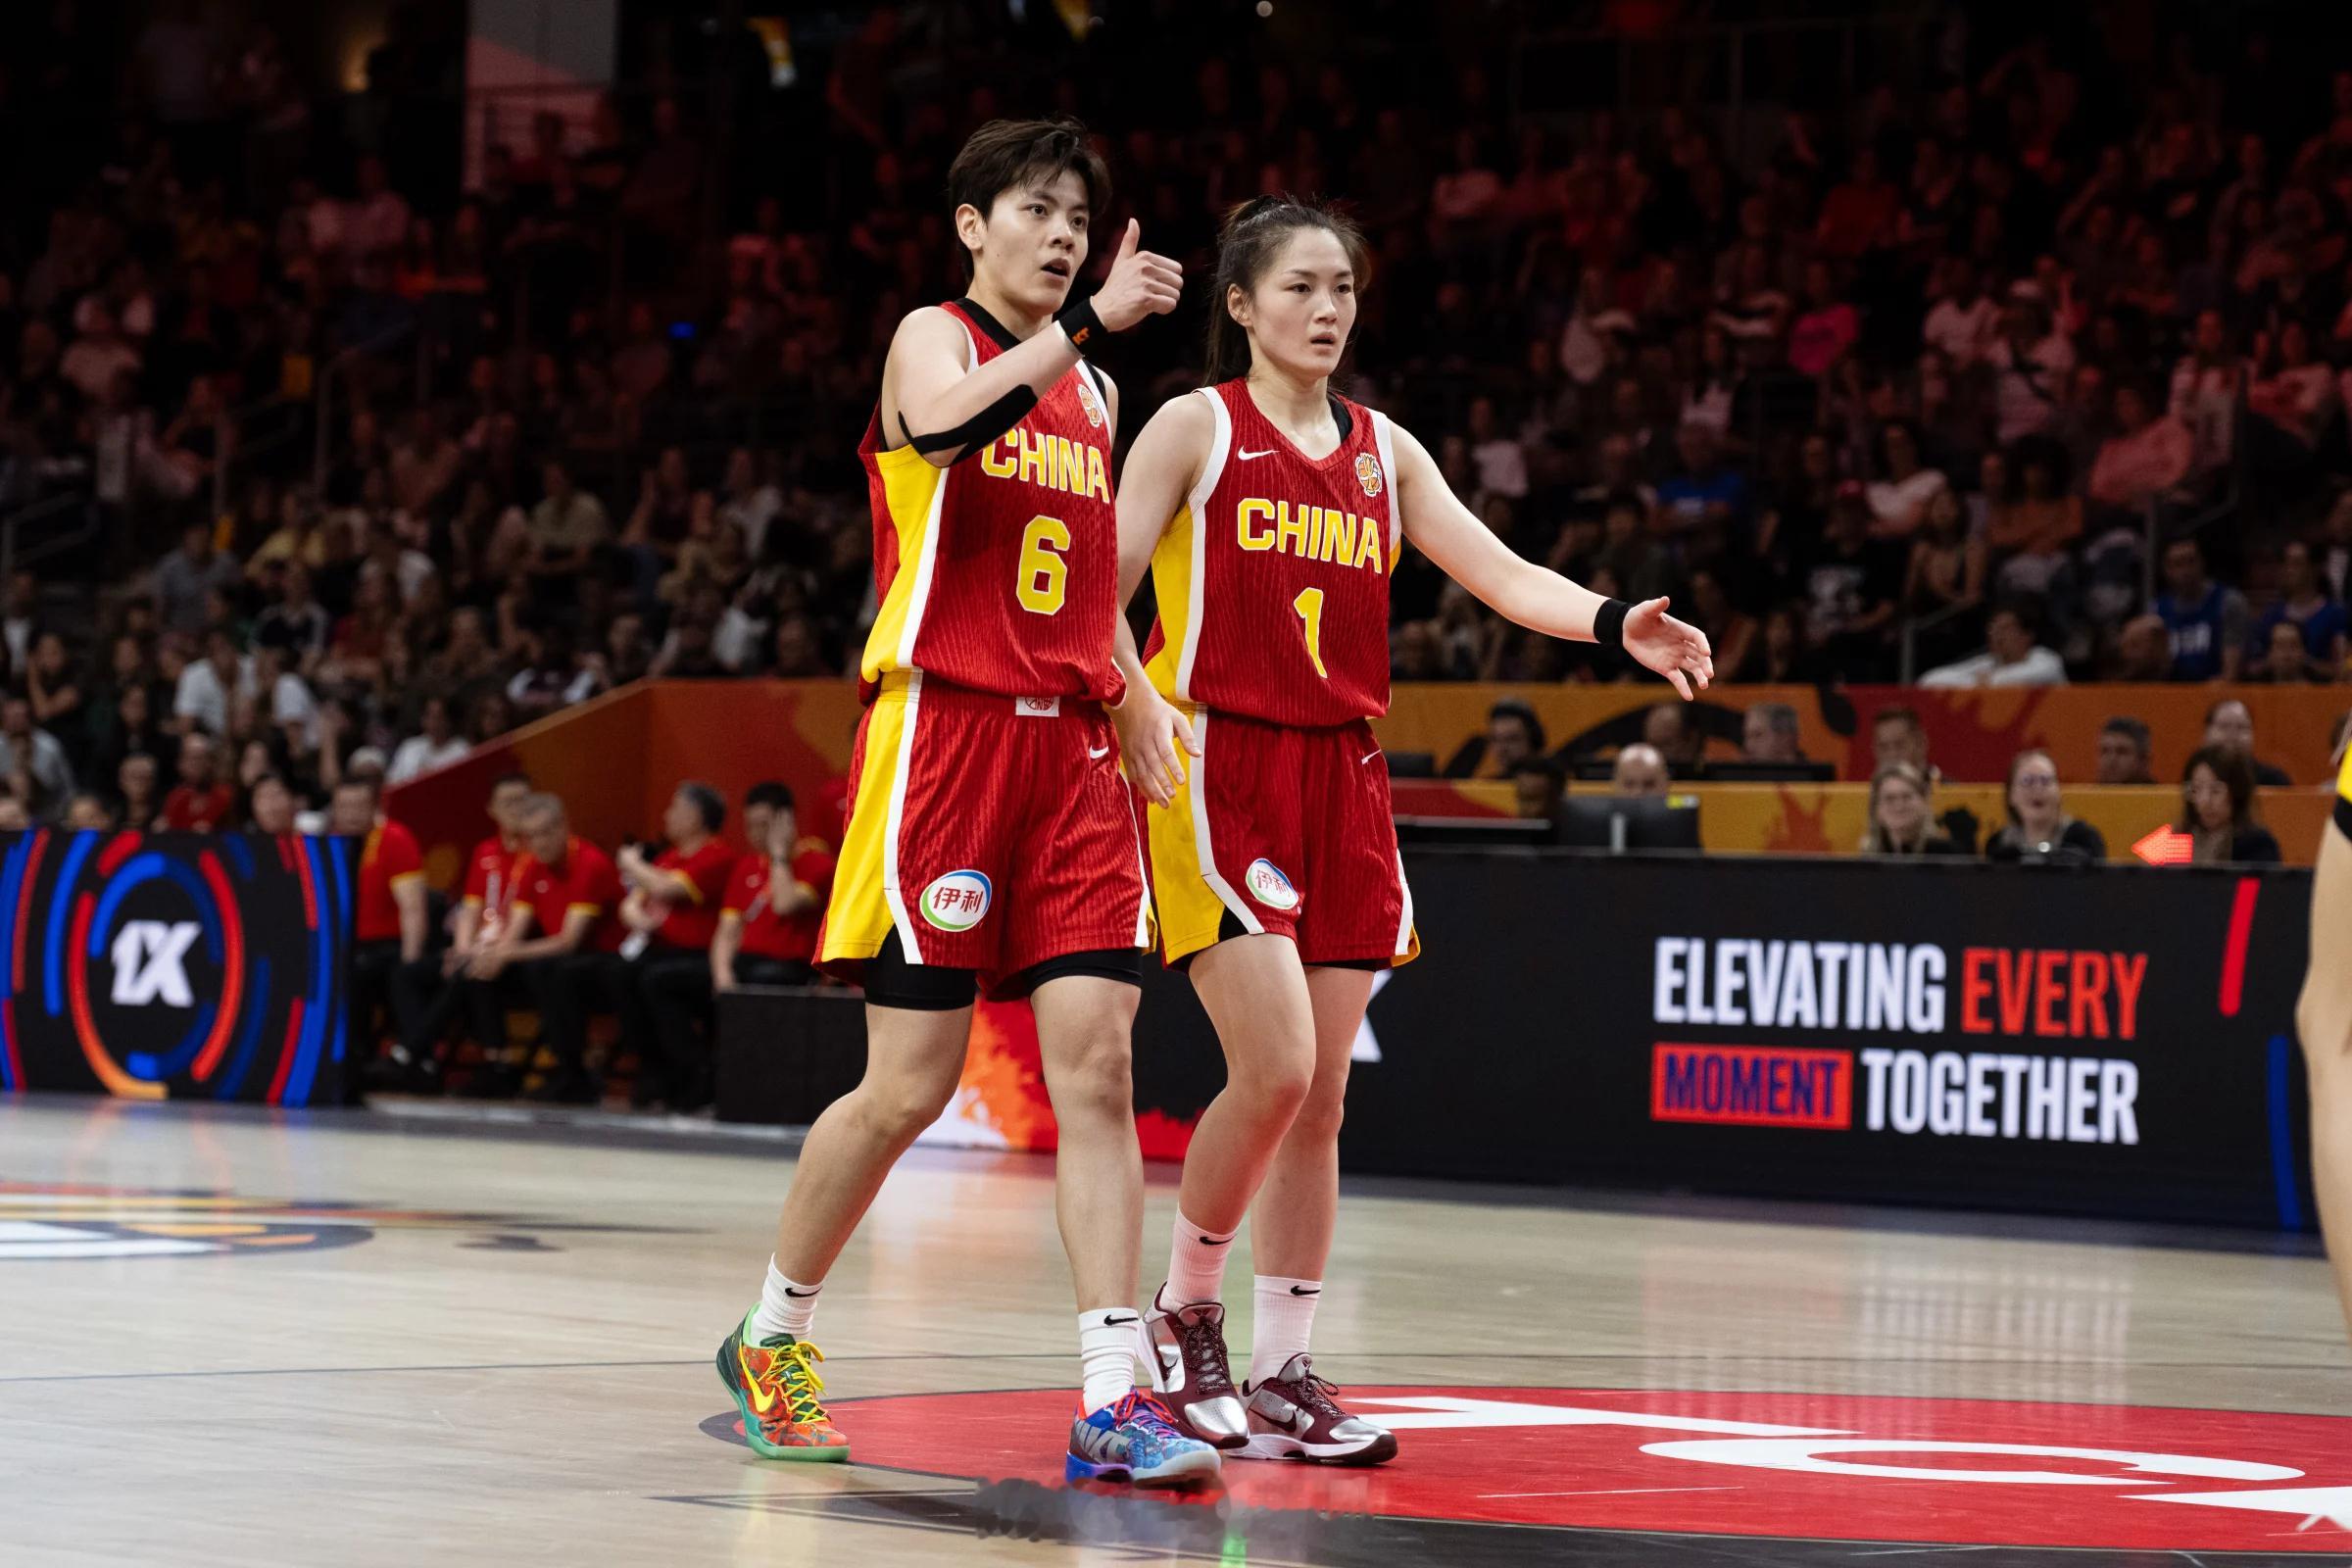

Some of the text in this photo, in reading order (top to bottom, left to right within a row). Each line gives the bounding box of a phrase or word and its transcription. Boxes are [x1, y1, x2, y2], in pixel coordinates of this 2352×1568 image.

[981, 427, 1110, 504] CHINA
[1015, 514, 1071, 615] 6
[1238, 498, 1382, 574] CHINA
[1293, 587, 1328, 678] 1
[933, 886, 984, 913] 伊利
[1653, 937, 2148, 1040] ELEVATING EVERY
[1665, 1047, 2139, 1145] MOMENT TOGETHER
